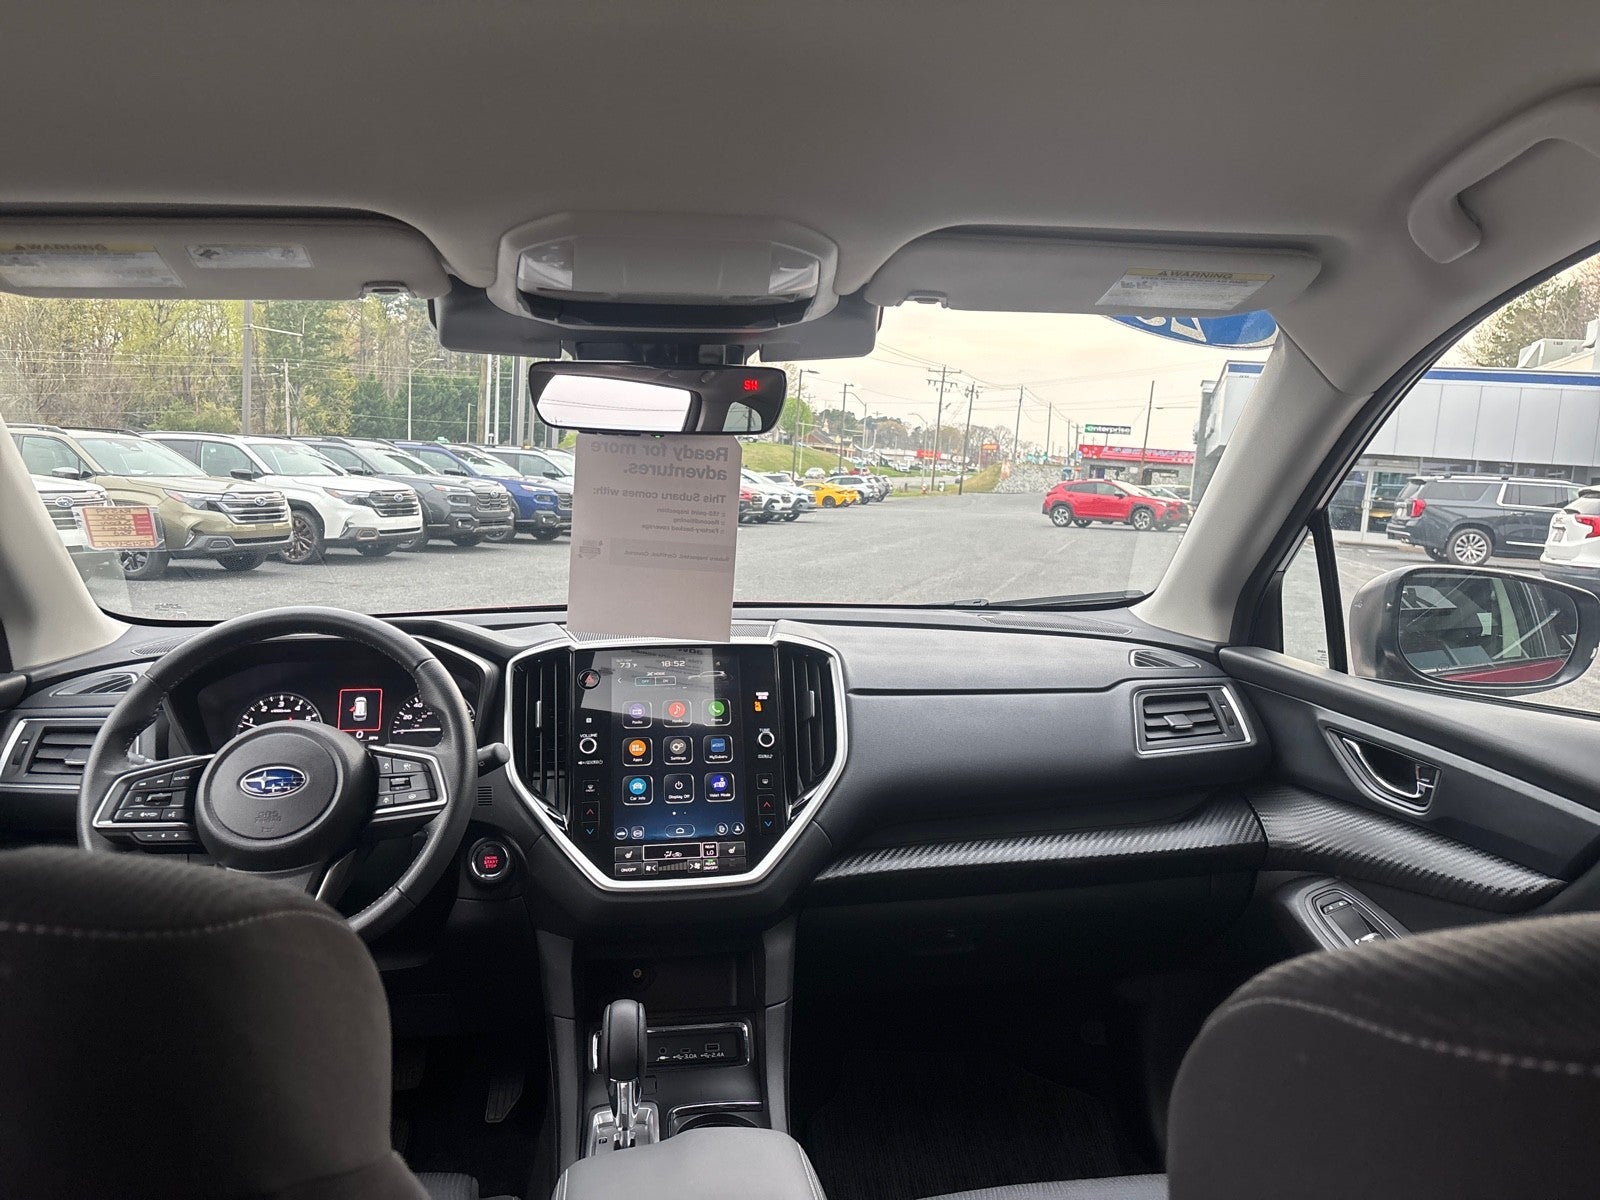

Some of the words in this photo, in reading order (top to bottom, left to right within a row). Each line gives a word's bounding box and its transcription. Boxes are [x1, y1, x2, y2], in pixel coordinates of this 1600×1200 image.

[1170, 271, 1233, 279] WARNING
[1086, 424, 1131, 434] enterprise
[355, 730, 364, 739] 0
